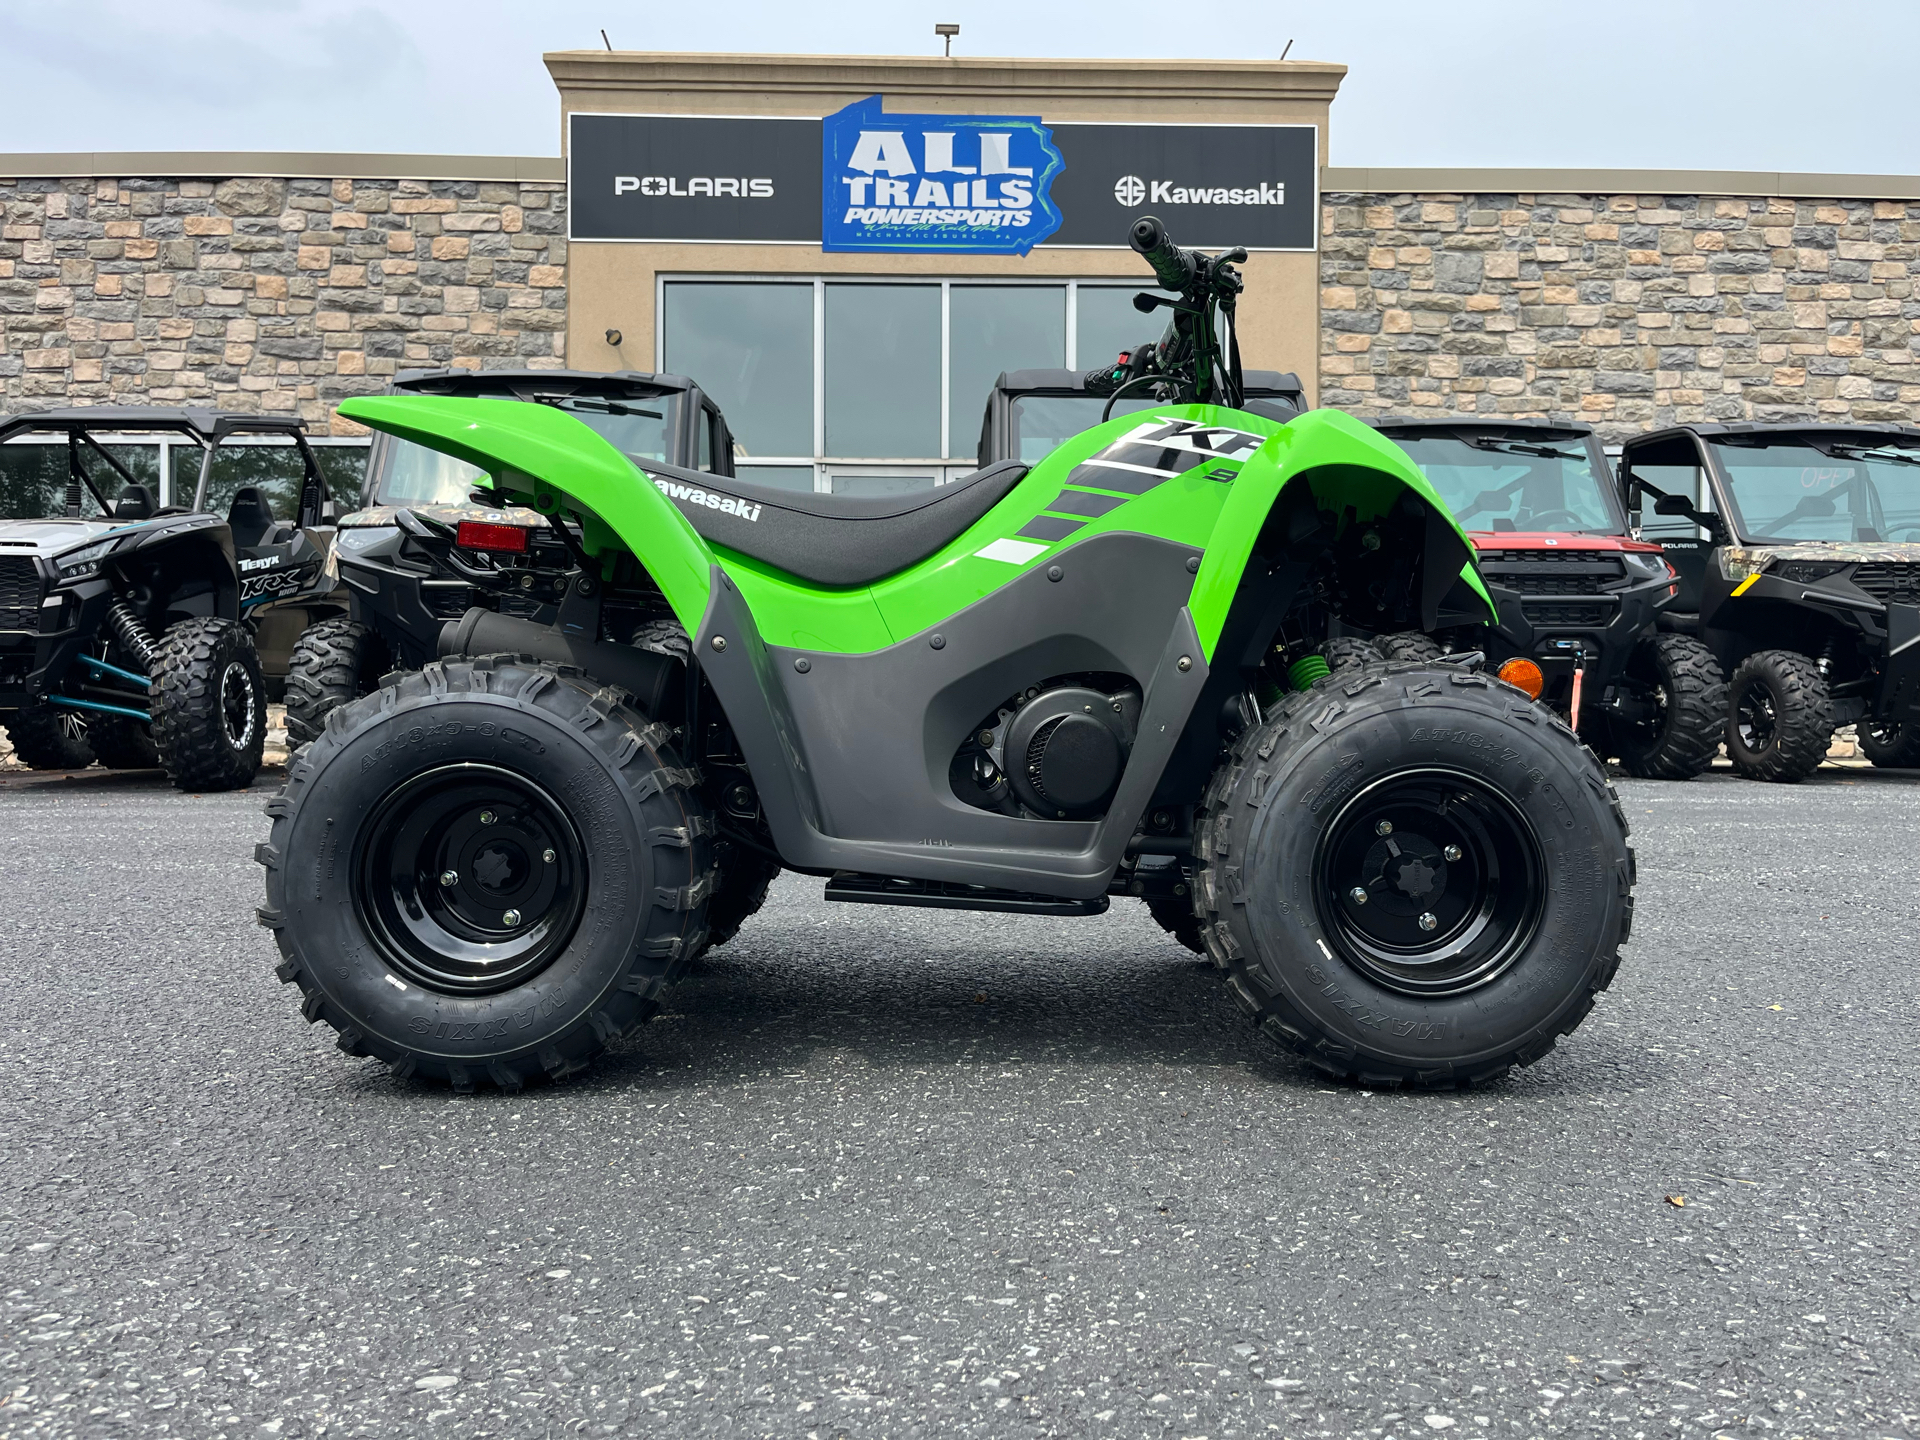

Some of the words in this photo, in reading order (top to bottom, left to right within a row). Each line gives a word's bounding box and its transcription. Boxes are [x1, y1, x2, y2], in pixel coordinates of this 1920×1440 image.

[847, 130, 1033, 178] ALL
[614, 176, 775, 198] POLARIS
[842, 176, 1033, 208] TRAILS
[1150, 179, 1286, 206] Kawasaki
[843, 207, 1033, 227] POWERSPORTS
[646, 474, 761, 522] awasaki
[240, 568, 302, 601] KRX
[407, 986, 566, 1040] MAXXIS
[1305, 963, 1446, 1040] MAXXIS
